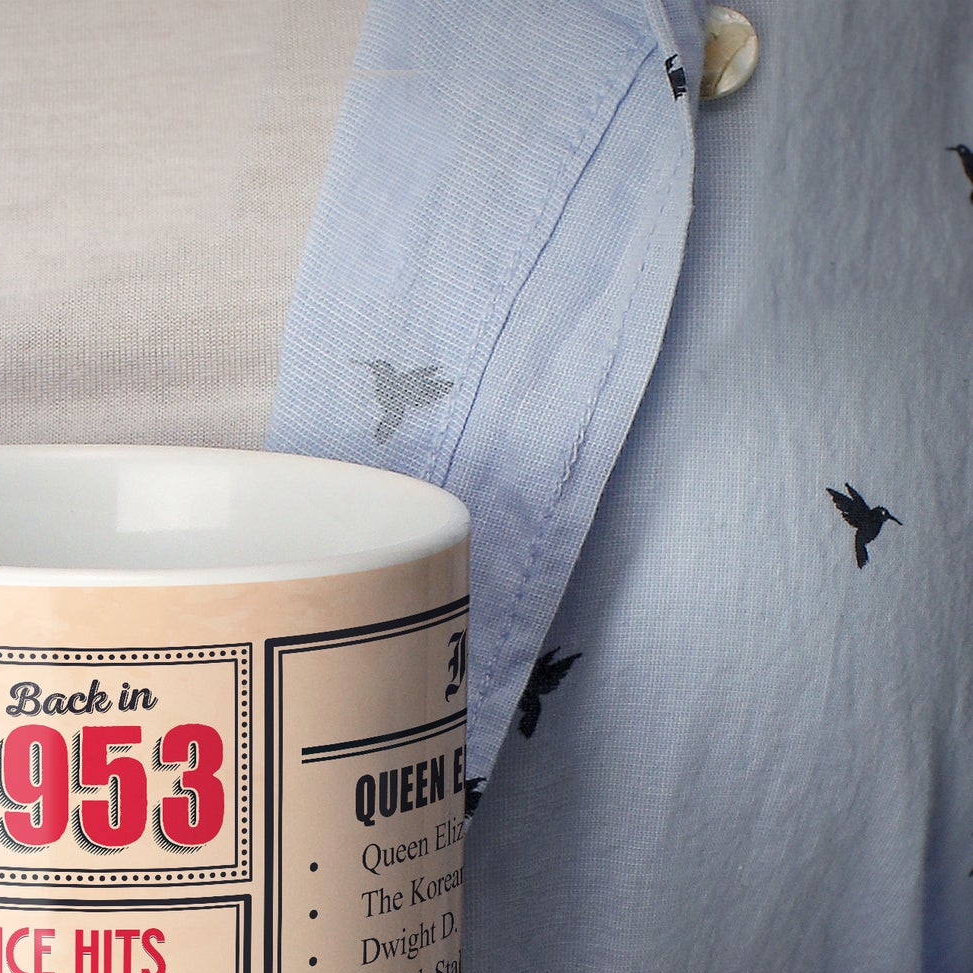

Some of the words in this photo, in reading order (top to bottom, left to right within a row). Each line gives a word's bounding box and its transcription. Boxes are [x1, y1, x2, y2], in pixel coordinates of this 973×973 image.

[5, 679, 111, 716] Back
[118, 682, 159, 711] in
[355, 755, 445, 827] QUEEN
[362, 836, 428, 876] Queen
[361, 890, 403, 918] The
[361, 920, 436, 966] Dwight
[441, 911, 458, 940] D.
